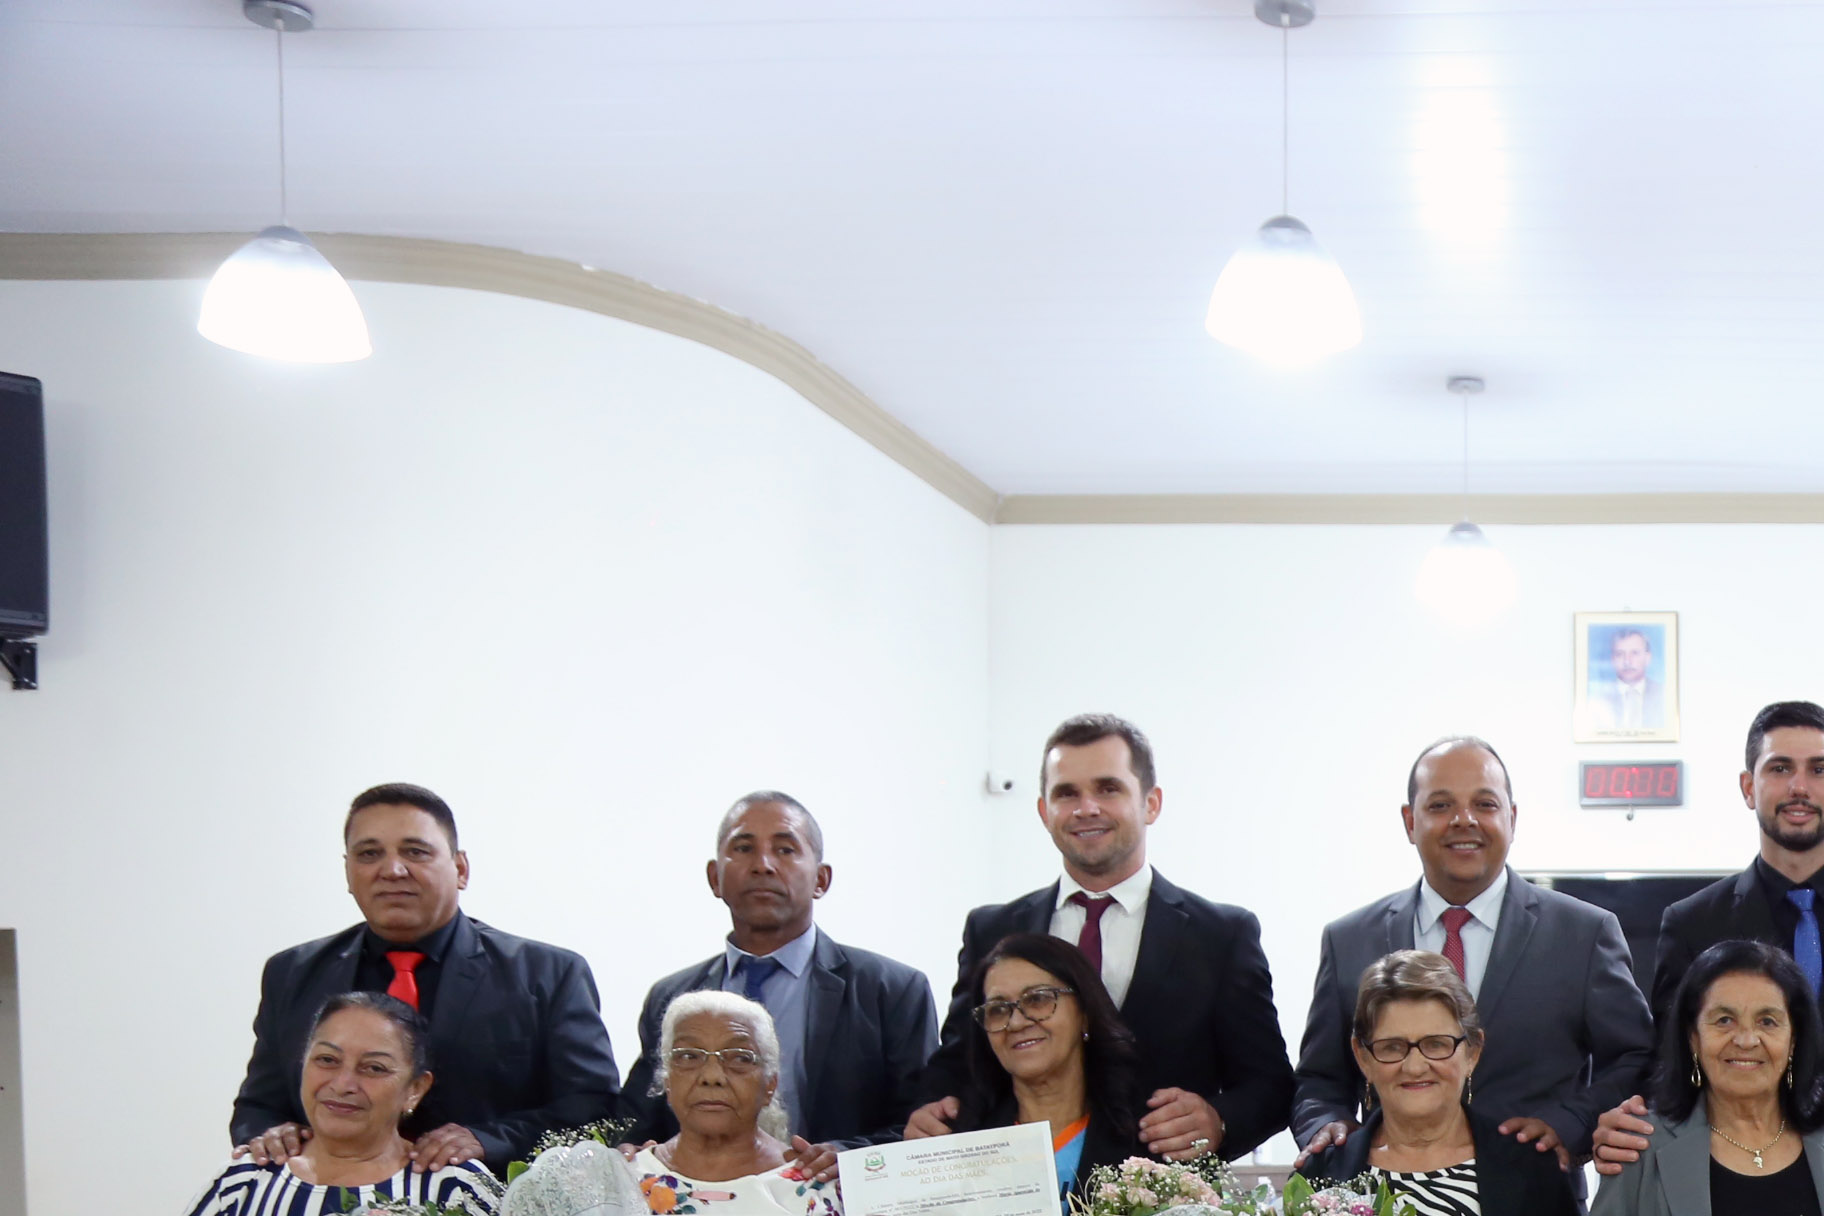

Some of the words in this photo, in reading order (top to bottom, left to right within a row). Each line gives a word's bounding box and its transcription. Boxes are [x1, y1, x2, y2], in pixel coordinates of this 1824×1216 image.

[933, 1148, 964, 1157] MUNICIPAL
[932, 1165, 942, 1173] DE
[920, 1177, 931, 1185] AO
[933, 1174, 947, 1183] DIA
[949, 1172, 964, 1181] DAS
